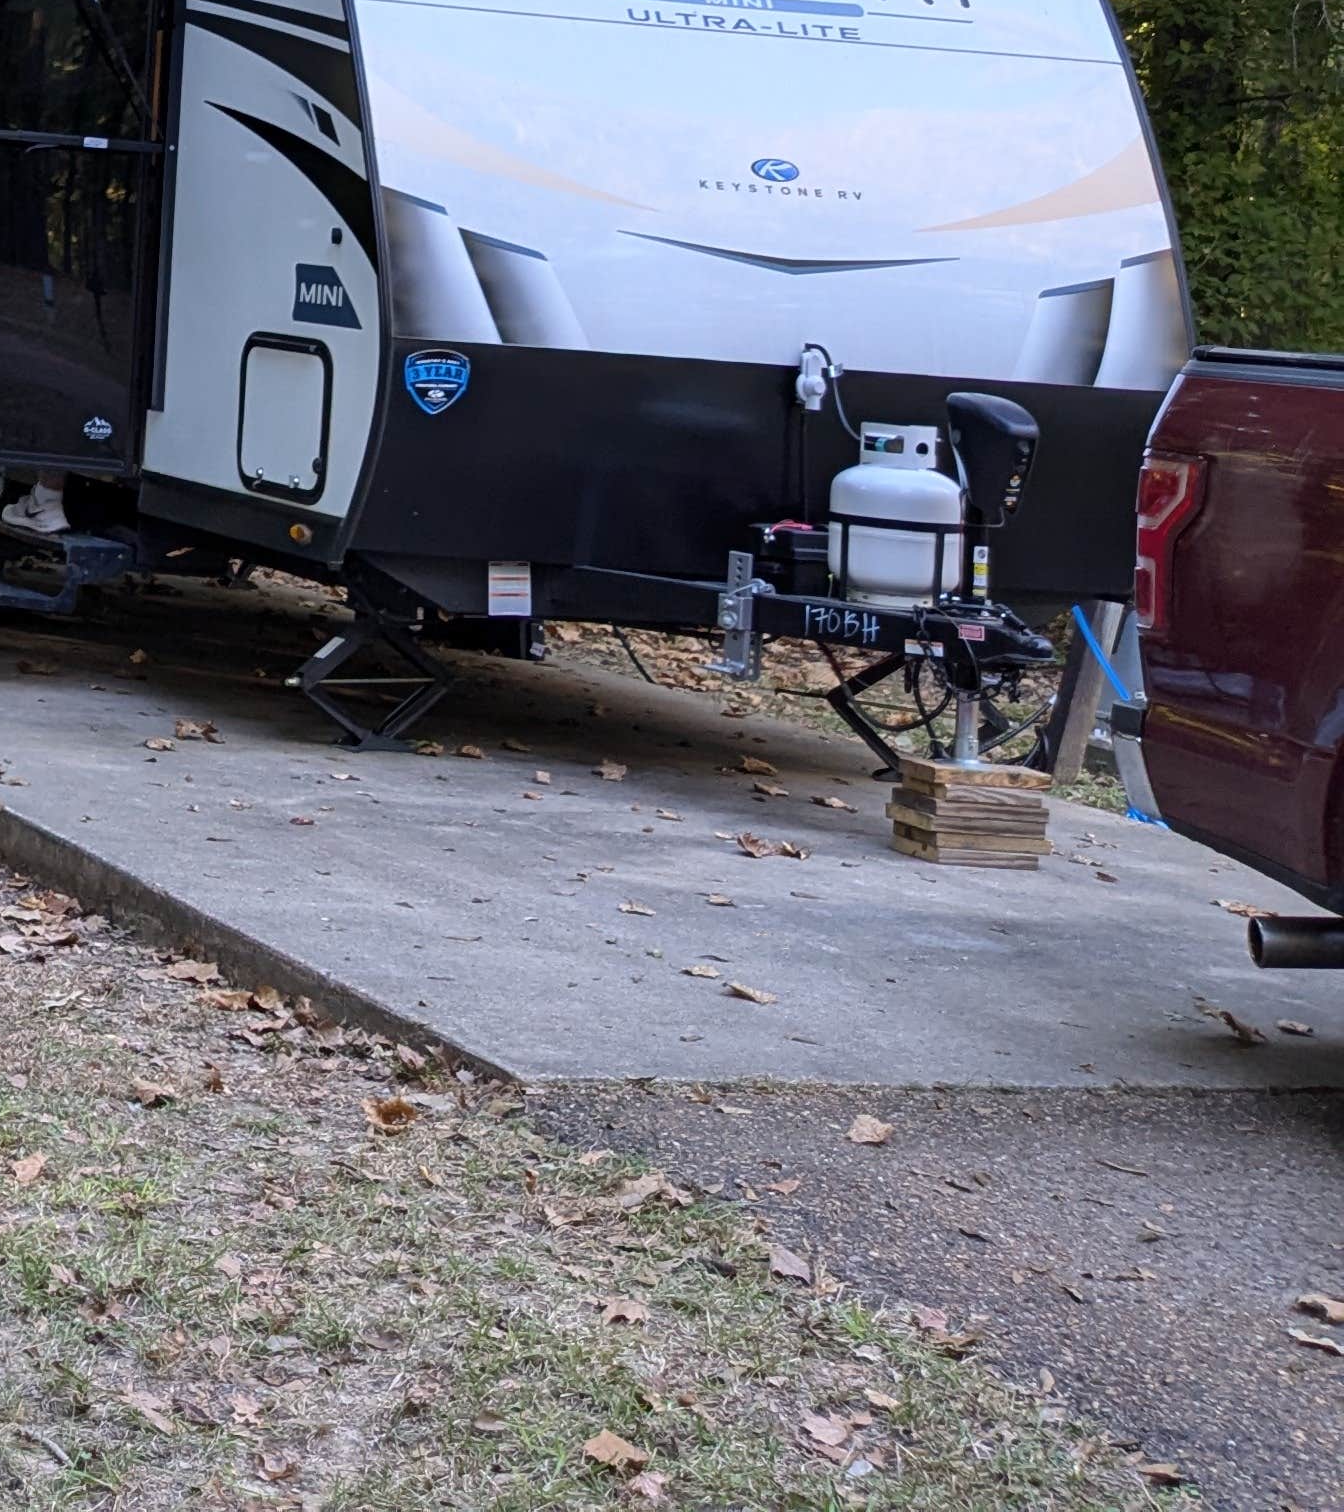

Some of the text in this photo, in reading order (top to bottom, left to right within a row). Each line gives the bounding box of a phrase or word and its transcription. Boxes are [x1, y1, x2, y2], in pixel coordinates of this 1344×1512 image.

[627, 8, 861, 40] ULTRA-LITE
[698, 179, 863, 201] KEYSTONE RV
[299, 282, 343, 307] MINI
[411, 365, 464, 380] 3 YEAR
[805, 604, 880, 644] 170BH
